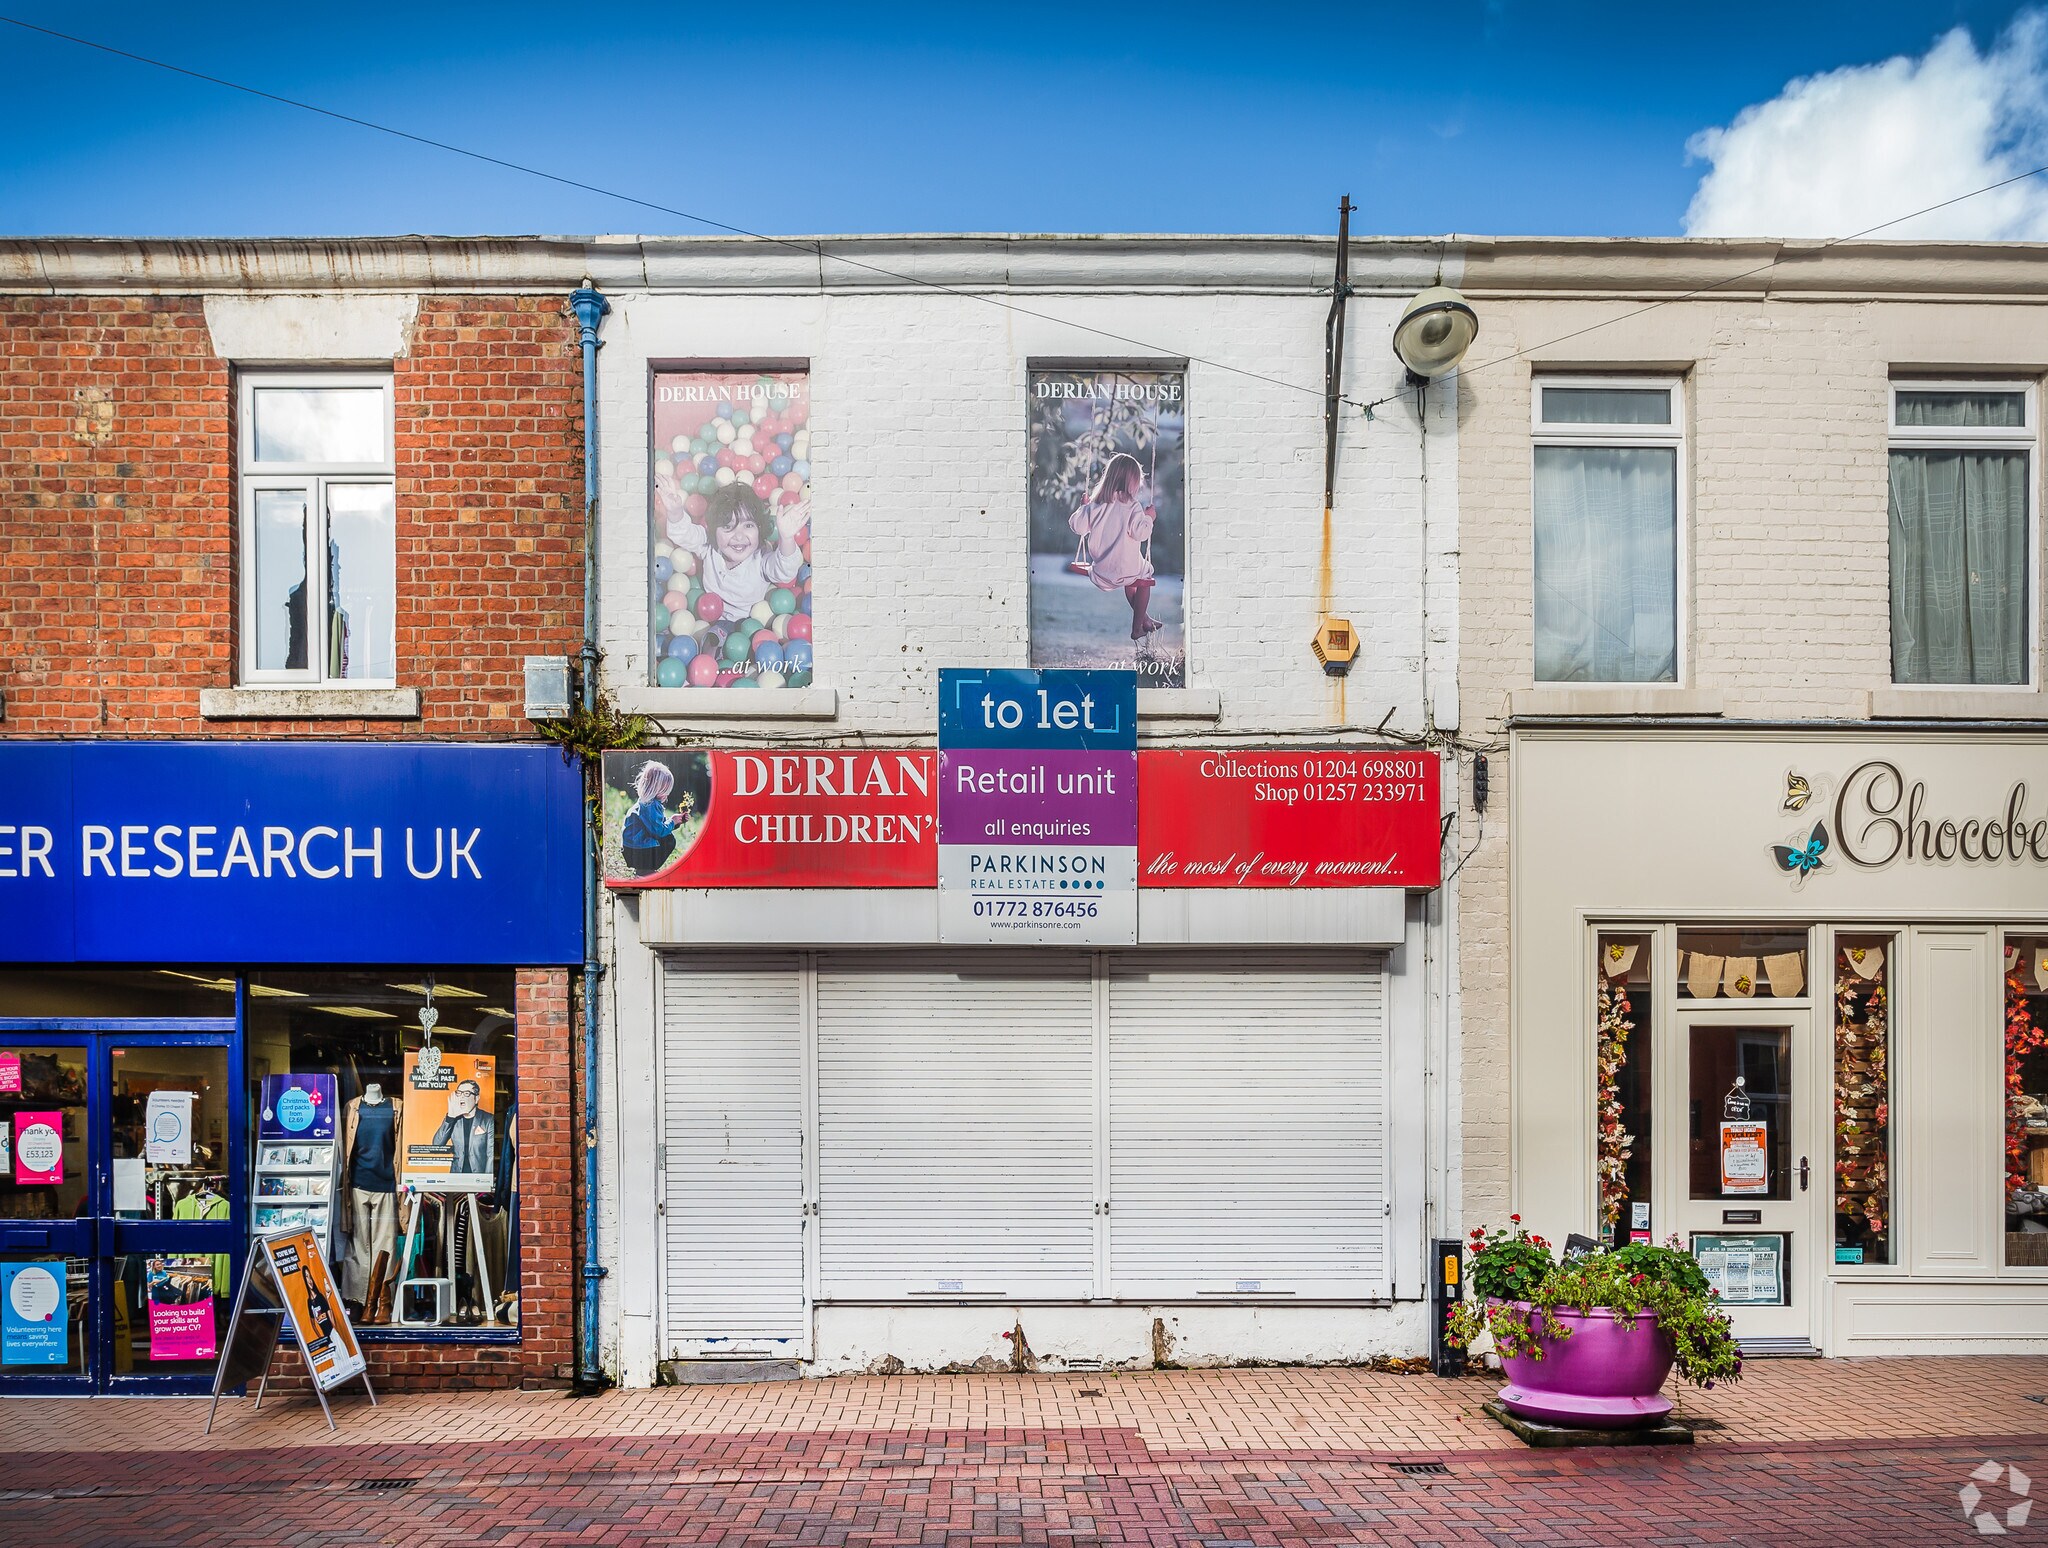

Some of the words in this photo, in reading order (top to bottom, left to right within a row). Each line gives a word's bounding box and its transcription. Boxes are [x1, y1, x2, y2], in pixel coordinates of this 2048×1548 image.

[659, 386, 731, 402] DERIAN
[736, 383, 801, 401] HOUSE
[1036, 382, 1110, 400] DERIAN
[1116, 384, 1181, 401] HOUSE
[757, 656, 803, 674] work
[1136, 656, 1180, 676] work
[981, 691, 1024, 730] to
[1037, 689, 1095, 730] let
[732, 756, 932, 797] DERIAN
[1200, 760, 1298, 778] Collections
[1303, 760, 1358, 778] 01204
[1362, 760, 1426, 778] 698801
[957, 765, 1044, 794] Retail
[1057, 766, 1116, 794] unit
[1254, 783, 1298, 806] Shop
[1303, 784, 1357, 802] 01257
[1362, 784, 1426, 802] 233971
[734, 814, 939, 844] CHILDREN'
[985, 819, 1005, 836] all
[1011, 820, 1091, 840] enquiries
[82, 826, 384, 880] RESEARCH
[406, 828, 482, 880] UK
[970, 855, 1105, 874] PARKINSON
[1146, 852, 1178, 875] the
[1184, 852, 1236, 875] most
[1235, 852, 1264, 884] of
[1261, 852, 1308, 886] every
[971, 880, 1003, 889] REAL
[1008, 880, 1055, 890] ESTATE
[974, 901, 1028, 918] 01772
[1032, 902, 1098, 918] 876456
[990, 920, 1081, 930] www.parkinsonre.com
[45, 1128, 59, 1136] you
[153, 1310, 179, 1318] Looking
